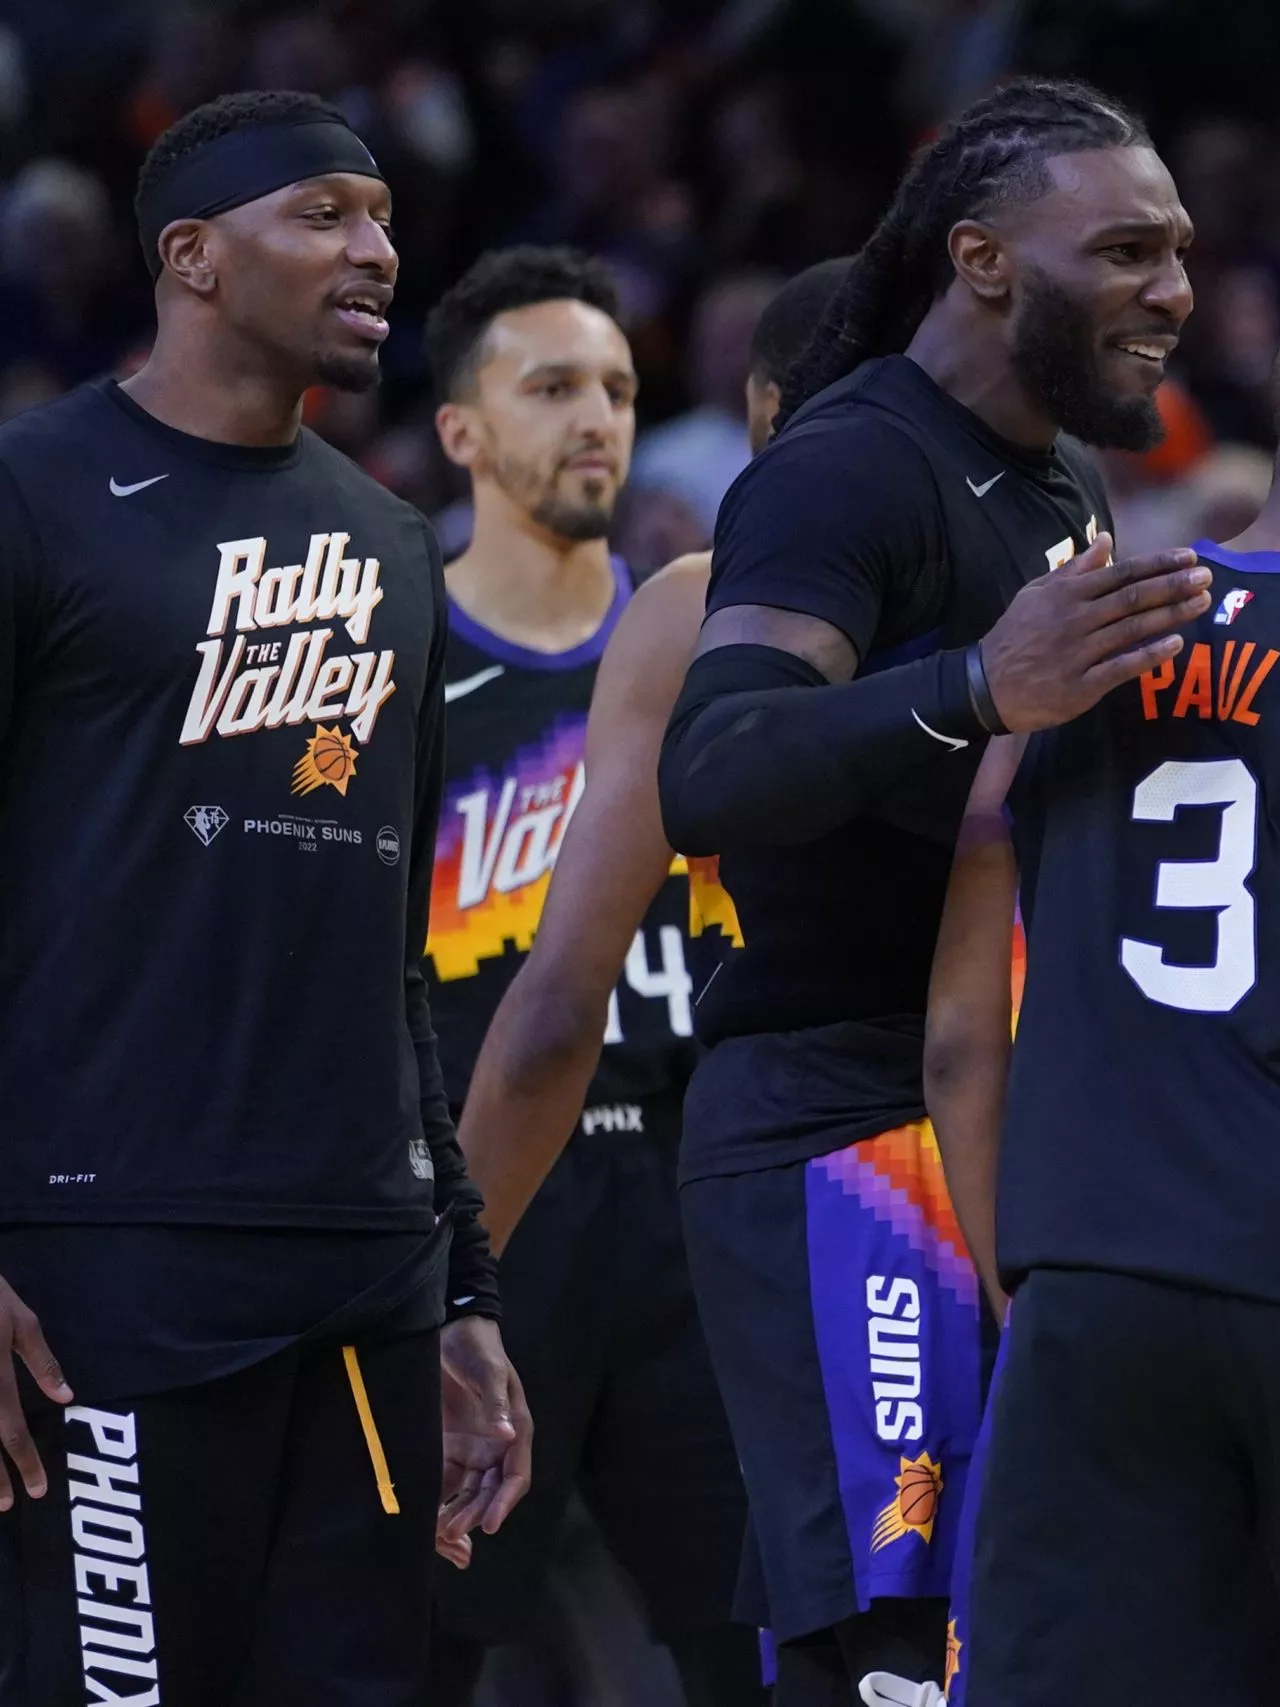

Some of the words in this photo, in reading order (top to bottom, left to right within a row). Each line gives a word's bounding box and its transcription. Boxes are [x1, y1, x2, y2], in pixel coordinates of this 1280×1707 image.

[206, 532, 384, 645] Rally
[179, 628, 396, 746] Valley
[247, 642, 281, 665] THE
[1140, 640, 1280, 726] PAUL
[244, 819, 316, 839] PHOENIX
[321, 826, 363, 844] SUNS
[298, 841, 318, 851] 2022
[456, 759, 586, 910] Val
[1120, 757, 1260, 1014] 3
[583, 1105, 644, 1136] PHX
[49, 1173, 97, 1185] DRI-FIT
[866, 1275, 923, 1441] SUNS
